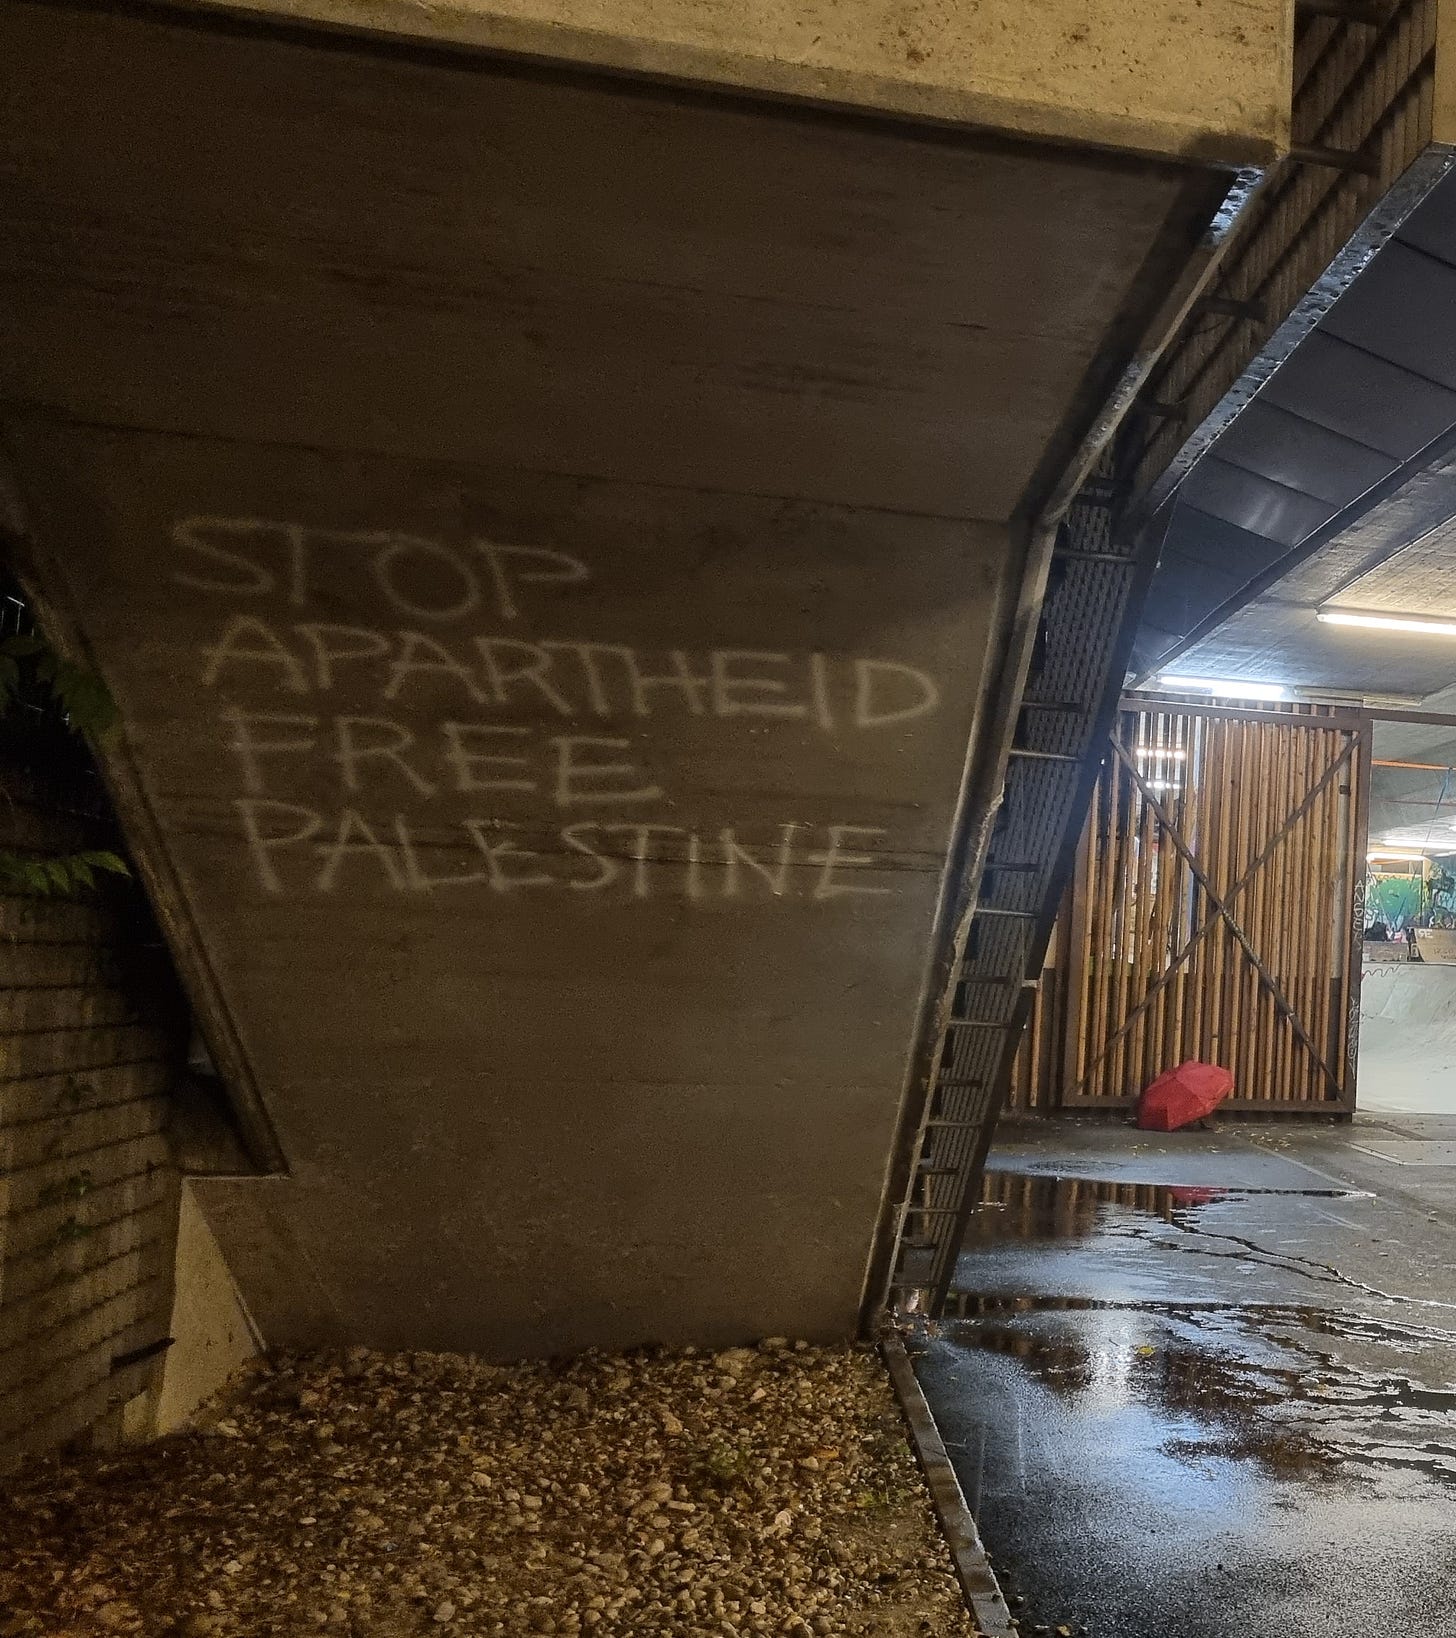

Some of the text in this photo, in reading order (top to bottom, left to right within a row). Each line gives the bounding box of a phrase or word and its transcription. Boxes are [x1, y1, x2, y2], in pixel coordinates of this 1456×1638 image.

[171, 515, 591, 621] STOP
[201, 612, 941, 730] APARTHEID
[220, 703, 665, 806] FREE
[233, 798, 893, 900] PALESTINE
